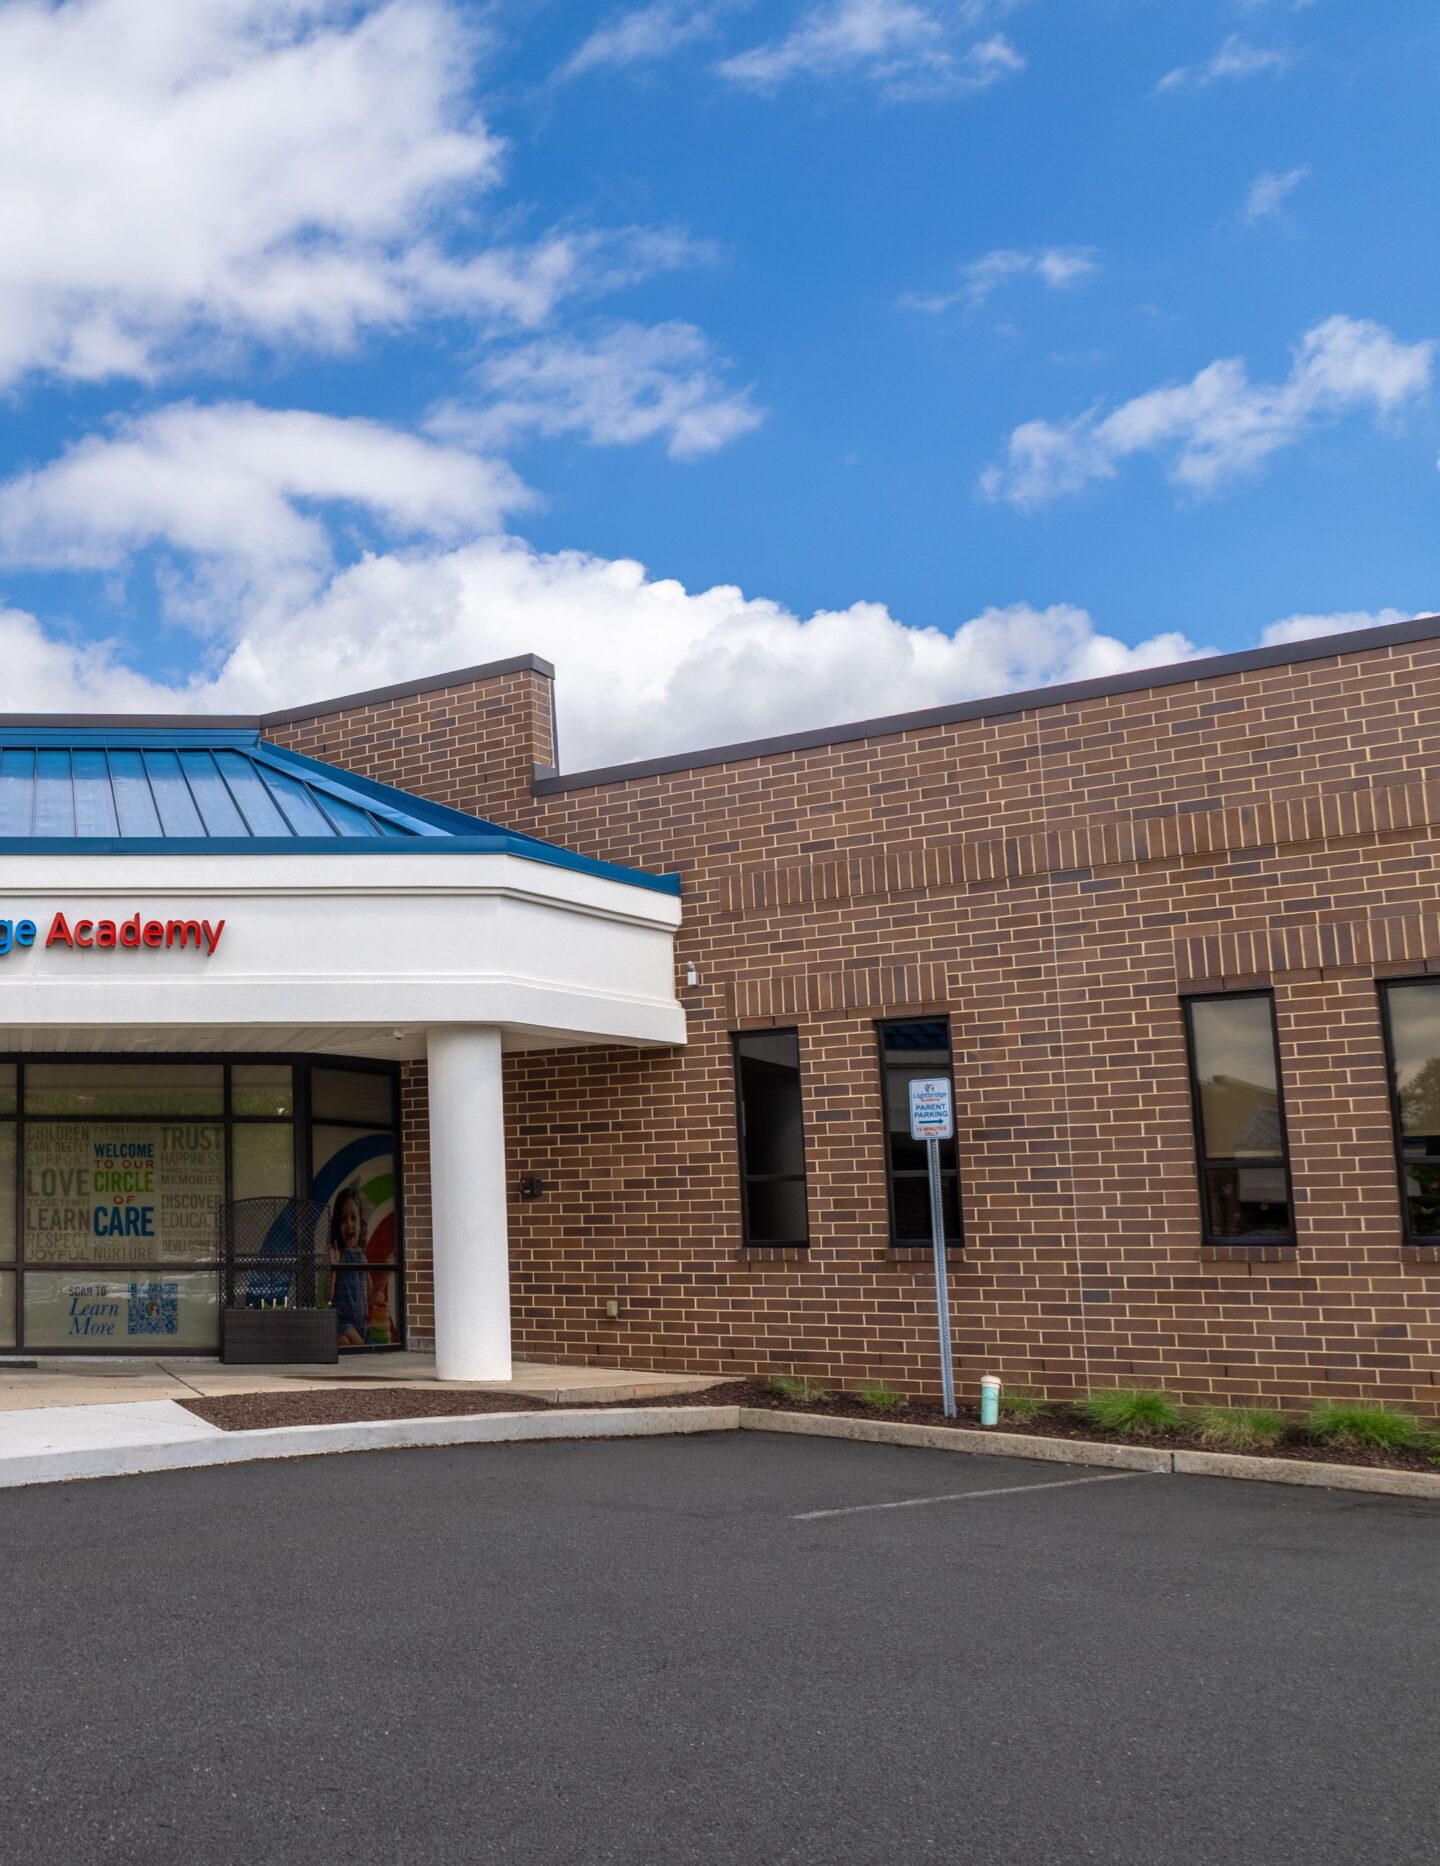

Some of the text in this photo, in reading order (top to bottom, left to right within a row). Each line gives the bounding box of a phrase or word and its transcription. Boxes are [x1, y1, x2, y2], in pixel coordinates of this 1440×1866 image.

[45, 912, 226, 955] Academy
[160, 1126, 223, 1150] TRUST
[27, 1142, 90, 1152] CARE DEEPLY
[94, 1143, 154, 1158] WELCOME
[27, 1153, 90, 1167] SUPPORT
[95, 1160, 154, 1168] TO OUR
[161, 1152, 222, 1166] HAPPINESS
[27, 1168, 90, 1197] LOVE
[94, 1171, 154, 1192] CIRCLE
[161, 1175, 222, 1185] MEMORIES
[113, 1195, 134, 1204] OF
[161, 1194, 222, 1209] DISCOVER
[27, 1208, 90, 1231] LEARN
[94, 1206, 154, 1236] CARE
[27, 1232, 90, 1248] RESPECT
[27, 1250, 89, 1260] JOYFUL
[94, 1247, 154, 1260] NURTURE
[68, 1286, 107, 1297] SCAN TO
[68, 1297, 119, 1316] Learn
[68, 1316, 116, 1335] More
